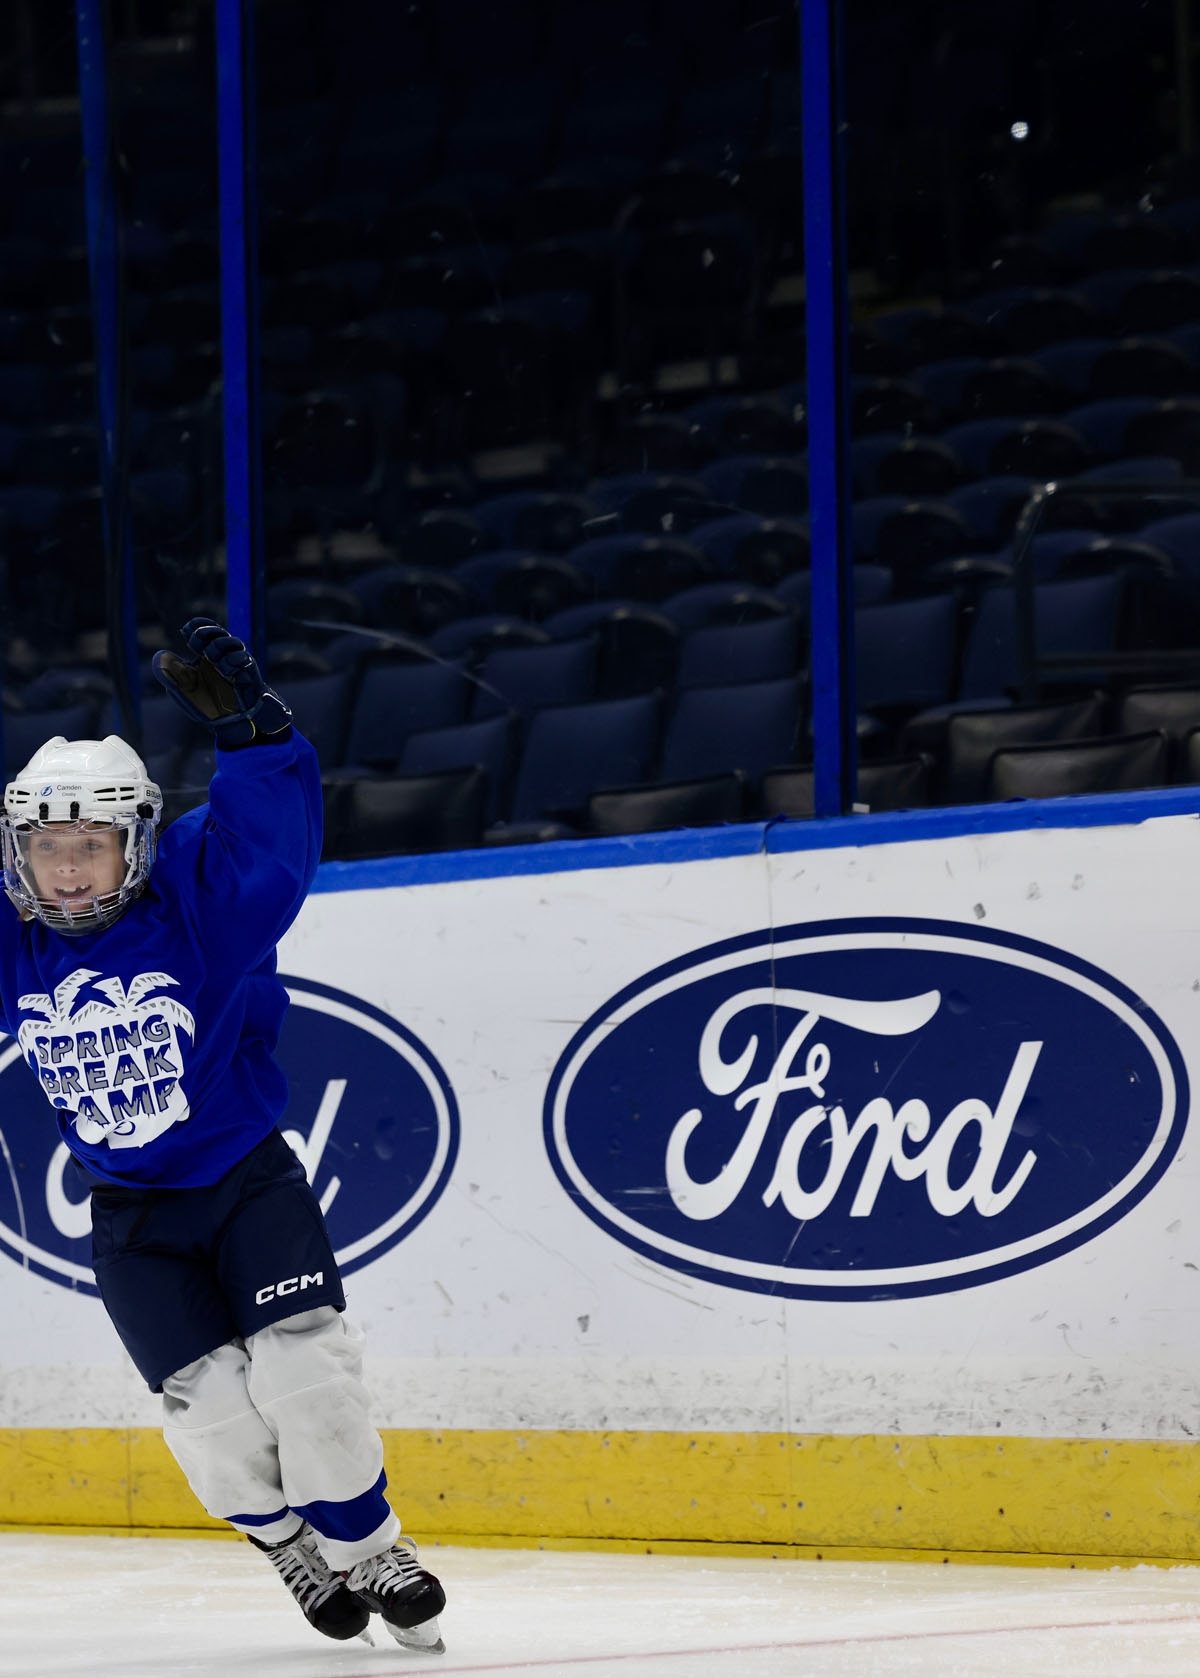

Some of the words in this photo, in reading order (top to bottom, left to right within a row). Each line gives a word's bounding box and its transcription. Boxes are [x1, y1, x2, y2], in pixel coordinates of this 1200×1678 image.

[35, 1014, 171, 1065] SPRING
[40, 1043, 178, 1095] BREAK
[54, 1077, 178, 1128] AMP
[666, 987, 1043, 1220] Ford
[255, 1271, 324, 1306] CCM
